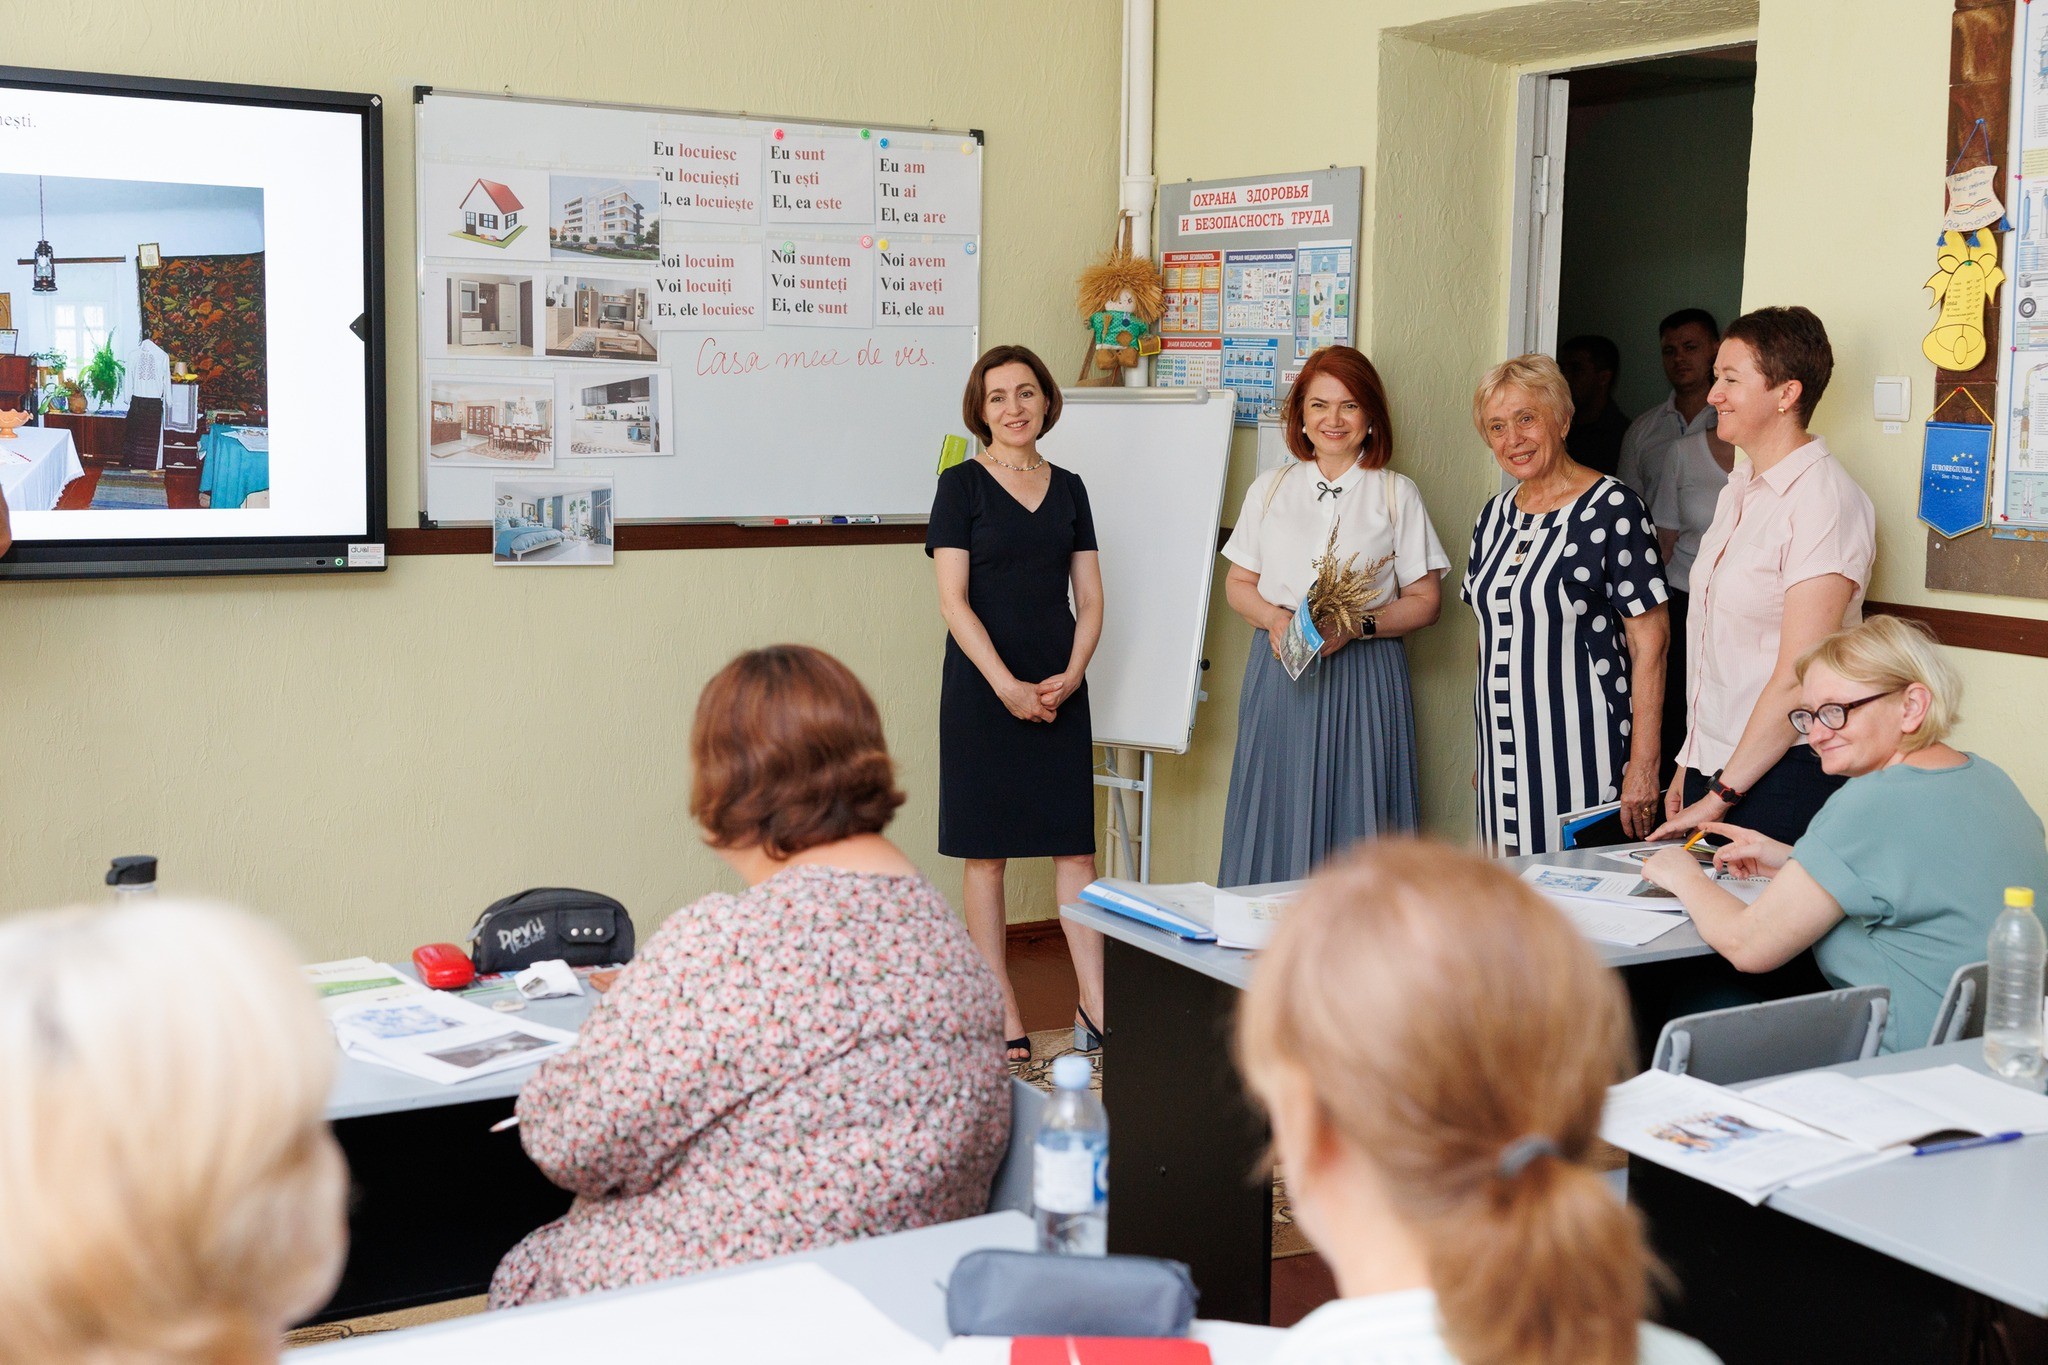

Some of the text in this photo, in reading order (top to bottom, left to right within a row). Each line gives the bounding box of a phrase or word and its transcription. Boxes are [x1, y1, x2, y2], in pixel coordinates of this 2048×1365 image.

[653, 141, 737, 161] Eu locuiesc
[771, 145, 825, 161] Eu sunt
[880, 158, 925, 174] Eu am
[679, 168, 739, 188] locuiești
[771, 170, 819, 188] Tu ești
[880, 182, 916, 198] Tu ai
[1193, 184, 1310, 207] ОХРАНА ЗДОРОВЬЯ
[661, 192, 754, 212] l, ea locuiește
[772, 194, 842, 211] El, ea este
[881, 207, 946, 225] El, ea are
[1182, 209, 1330, 232] И БЕЗОПАСНОСТЬ ТРУДА
[685, 254, 735, 268] locuim
[771, 249, 851, 267] Noi suntem
[880, 252, 946, 267] Noi avem
[656, 279, 732, 295] Voi locuiți
[771, 273, 847, 293] Voi sunteți
[881, 277, 943, 294] Voi aveți
[657, 303, 755, 317] Ei, ele locuiesc
[772, 297, 848, 315] Ei, ele sunt
[882, 301, 945, 318] Ei, ele au
[696, 337, 771, 376] Casa
[857, 338, 884, 366] de
[1931, 464, 1973, 474] EUROREGIUNEA
